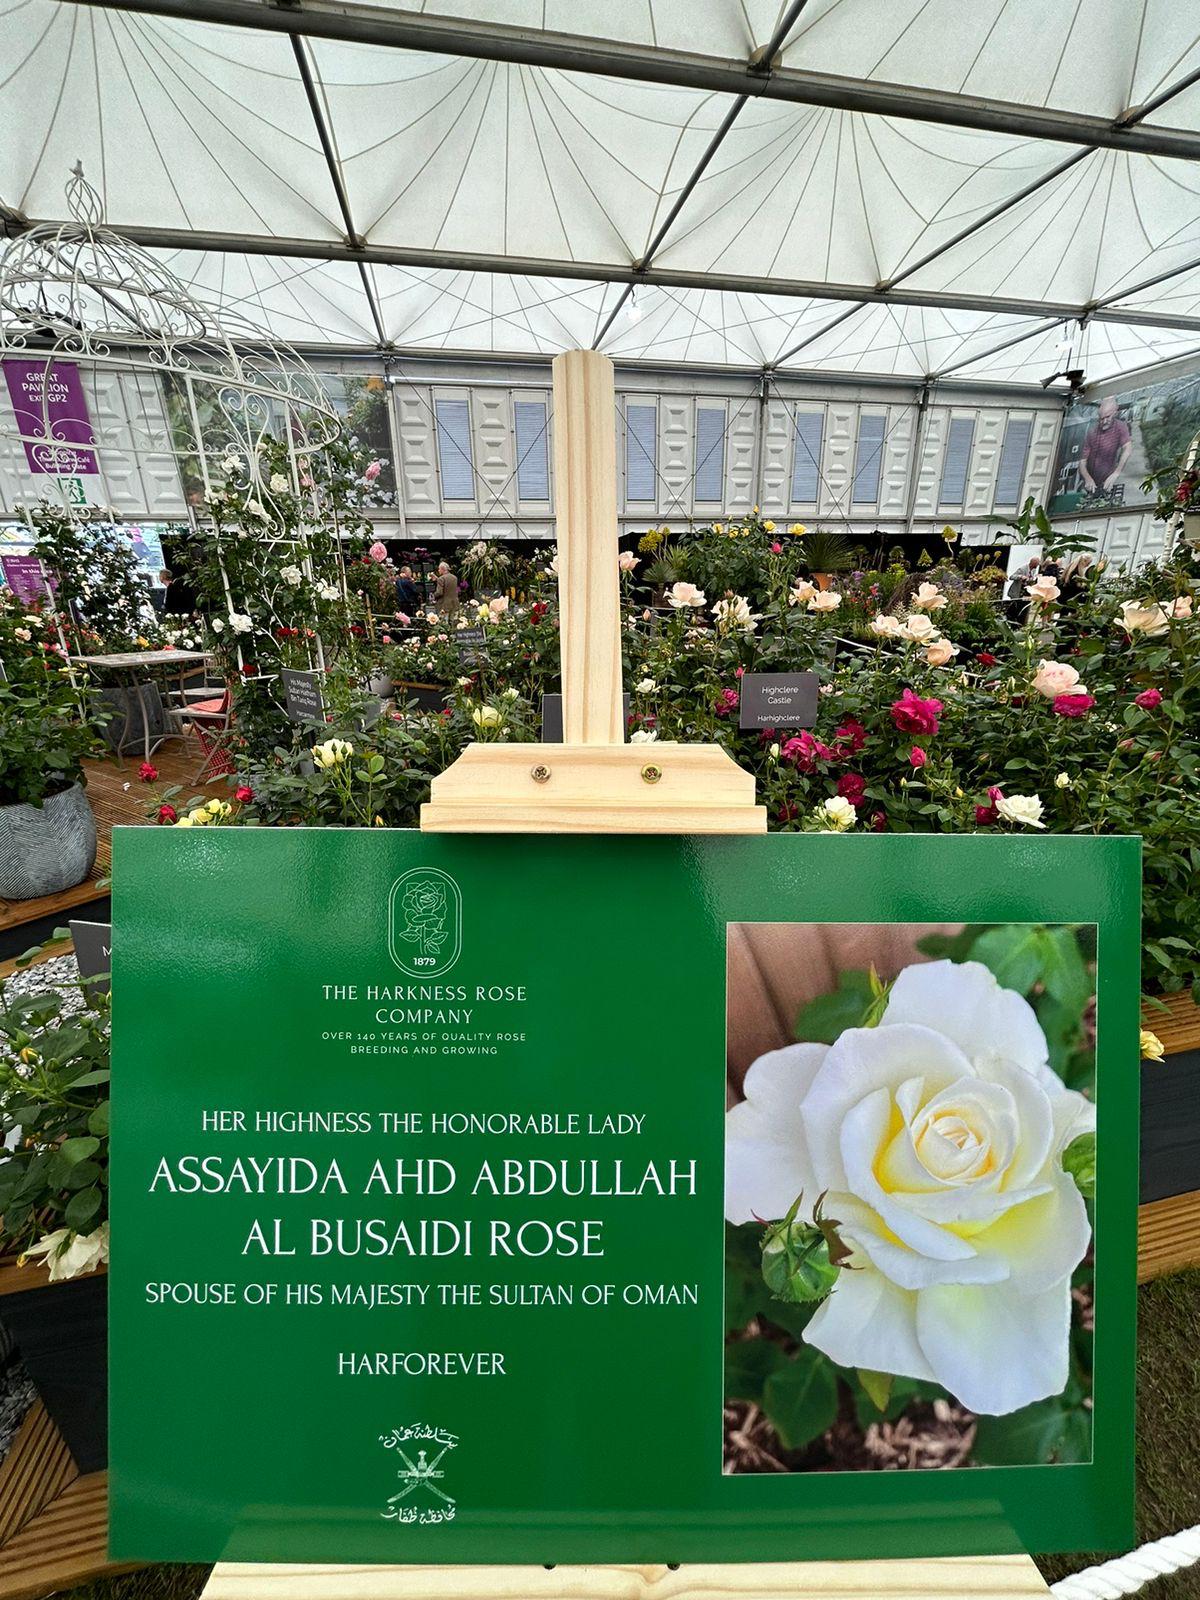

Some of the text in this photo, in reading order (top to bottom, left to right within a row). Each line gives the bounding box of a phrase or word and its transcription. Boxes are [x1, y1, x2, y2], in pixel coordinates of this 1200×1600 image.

[21, 382, 70, 393] PAVIION
[47, 393, 67, 403] GP2
[762, 686, 799, 695] Highclere
[767, 696, 792, 704] Castle
[757, 715, 800, 723] Harhighclere
[413, 957, 436, 966] 1879
[322, 985, 527, 1001] THE HARKNESS ROSE
[375, 1008, 473, 1024] COMPANY
[321, 1031, 526, 1041] OVER 140 YEARS OF QUALITY ROSE
[350, 1045, 498, 1055] BREEDING AND GROWING
[202, 1110, 646, 1135] HER HIGHNESS THE HONORABLE LADY
[148, 1156, 697, 1196] ASSAYIDA AHD ABDULLAH
[241, 1218, 604, 1257] AL BUSAIDI ROSE
[145, 1282, 698, 1310] SPOUSE OF HIS MAJESTY THE SULTAN OF OMAN
[338, 1352, 506, 1375] HARFOREVER
